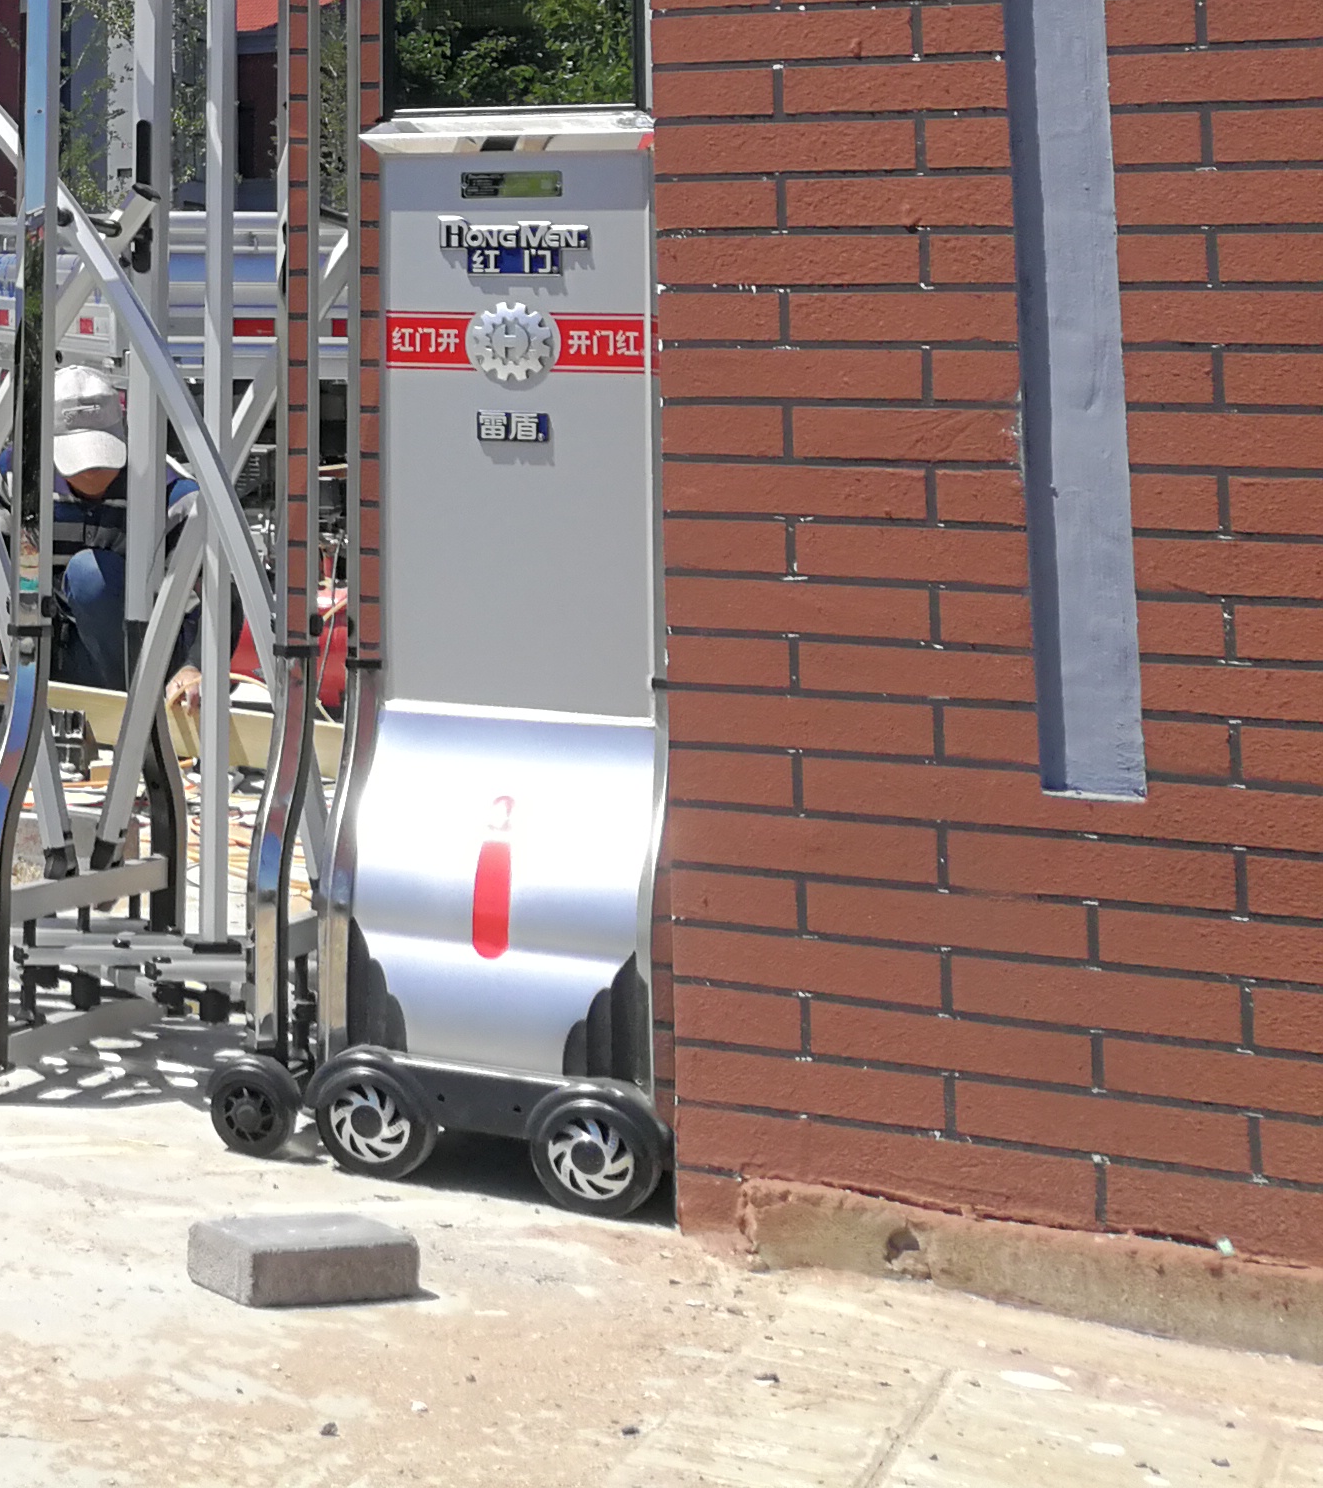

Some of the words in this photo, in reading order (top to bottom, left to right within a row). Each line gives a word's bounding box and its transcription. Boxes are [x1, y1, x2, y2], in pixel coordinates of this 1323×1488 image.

[472, 249, 552, 273] 红门
[391, 327, 460, 353] 红门开
[568, 330, 642, 356] 开门红
[479, 413, 540, 440] 雷盾
